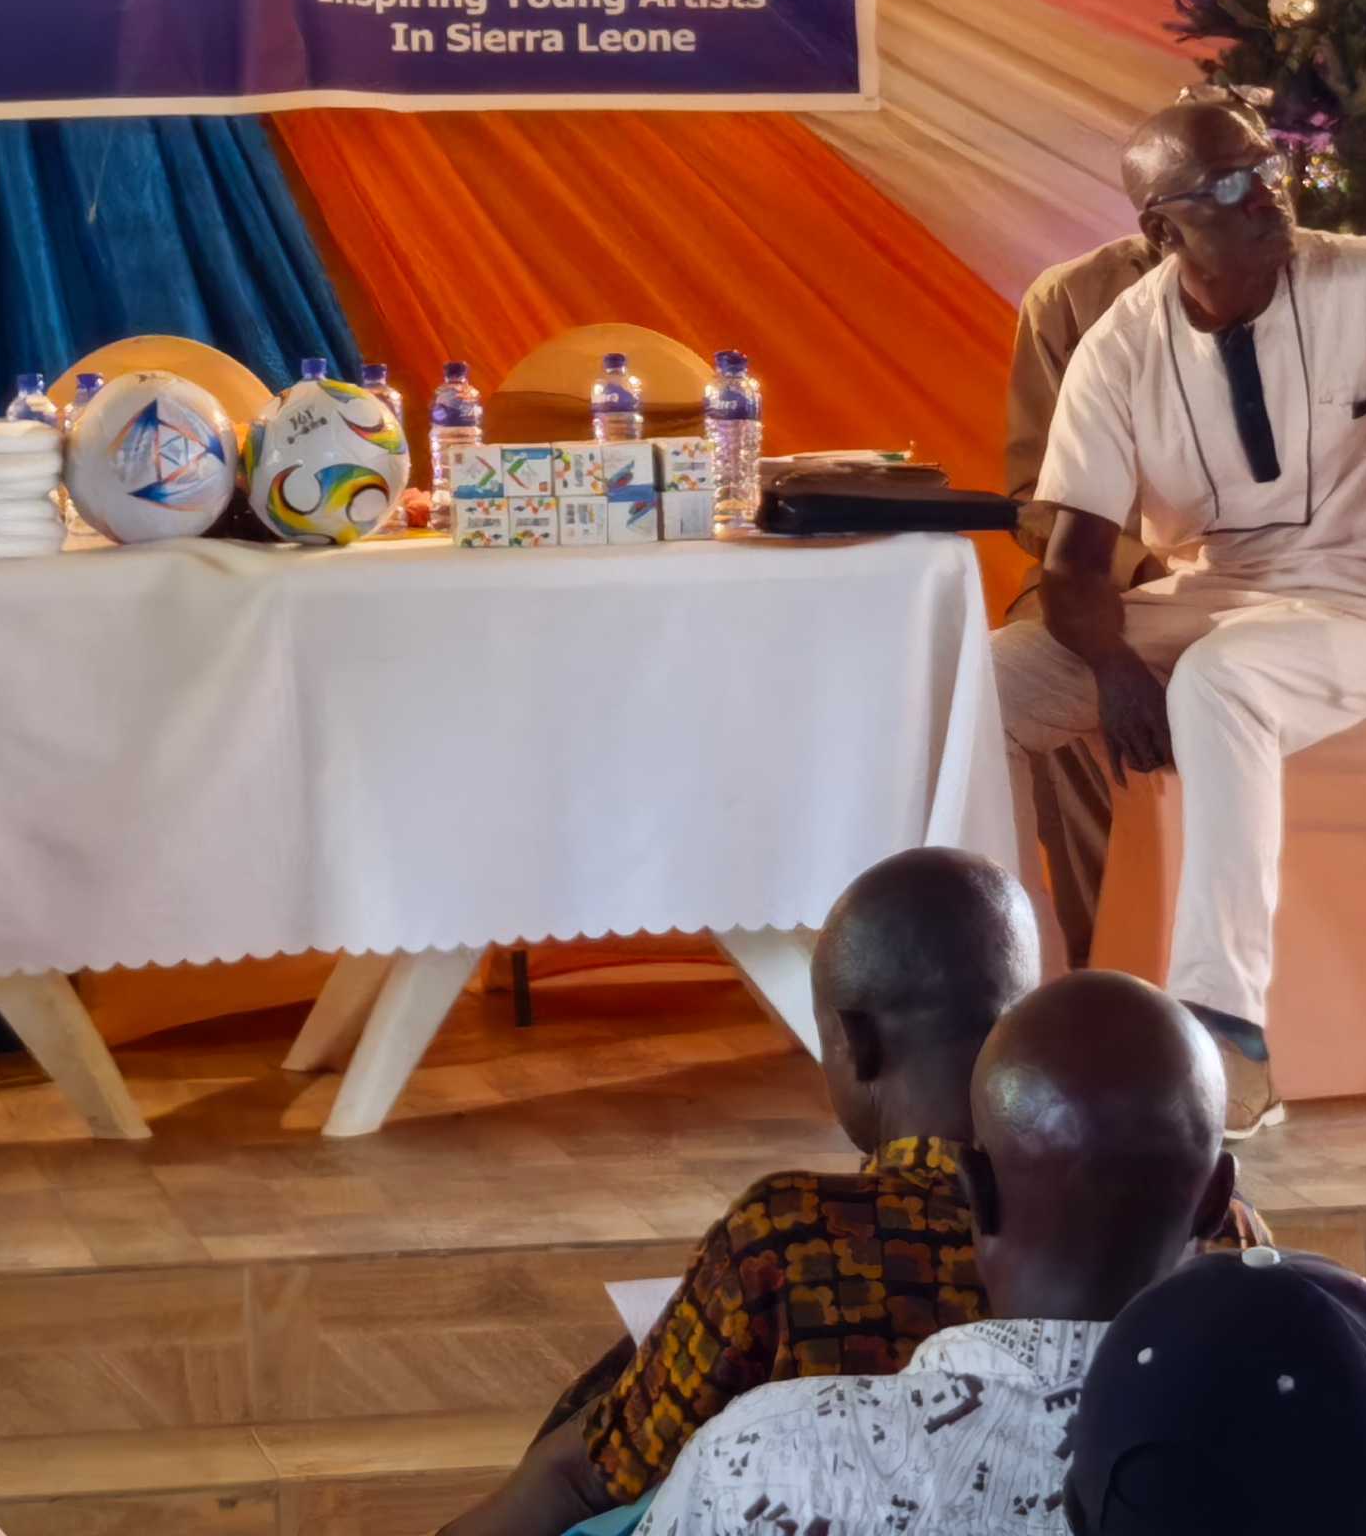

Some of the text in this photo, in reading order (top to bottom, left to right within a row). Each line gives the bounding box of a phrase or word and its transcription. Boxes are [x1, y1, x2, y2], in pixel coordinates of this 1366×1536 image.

[391, 22, 696, 52] In Sierra Leone
